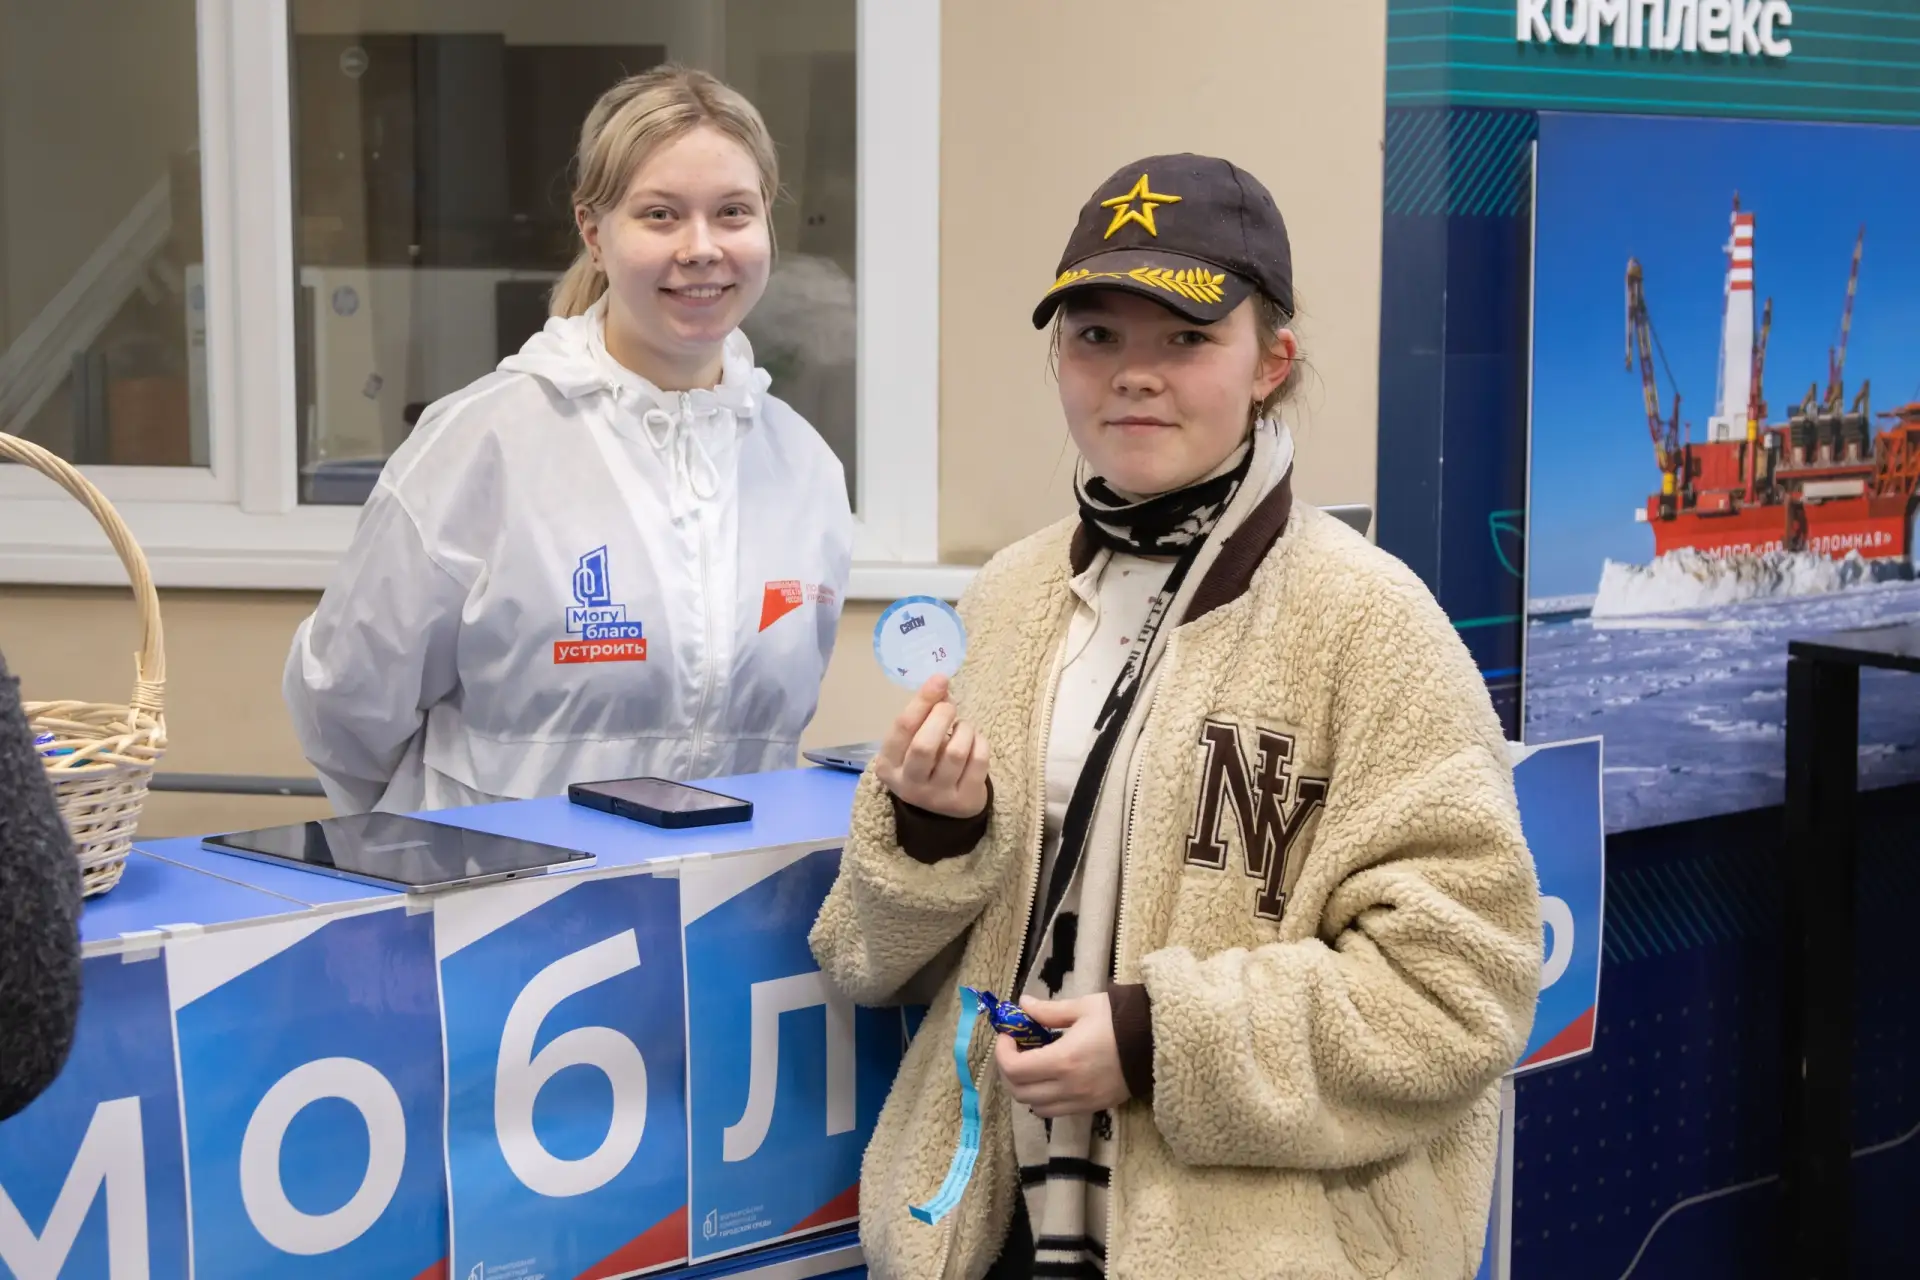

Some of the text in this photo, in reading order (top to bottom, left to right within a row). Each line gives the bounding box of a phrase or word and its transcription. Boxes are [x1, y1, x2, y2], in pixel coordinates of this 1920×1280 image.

[1516, 0, 1793, 57] комплекс
[572, 609, 619, 624] Могу
[586, 623, 639, 639] благо
[559, 643, 645, 660] устроить
[1184, 718, 1330, 921] NY
